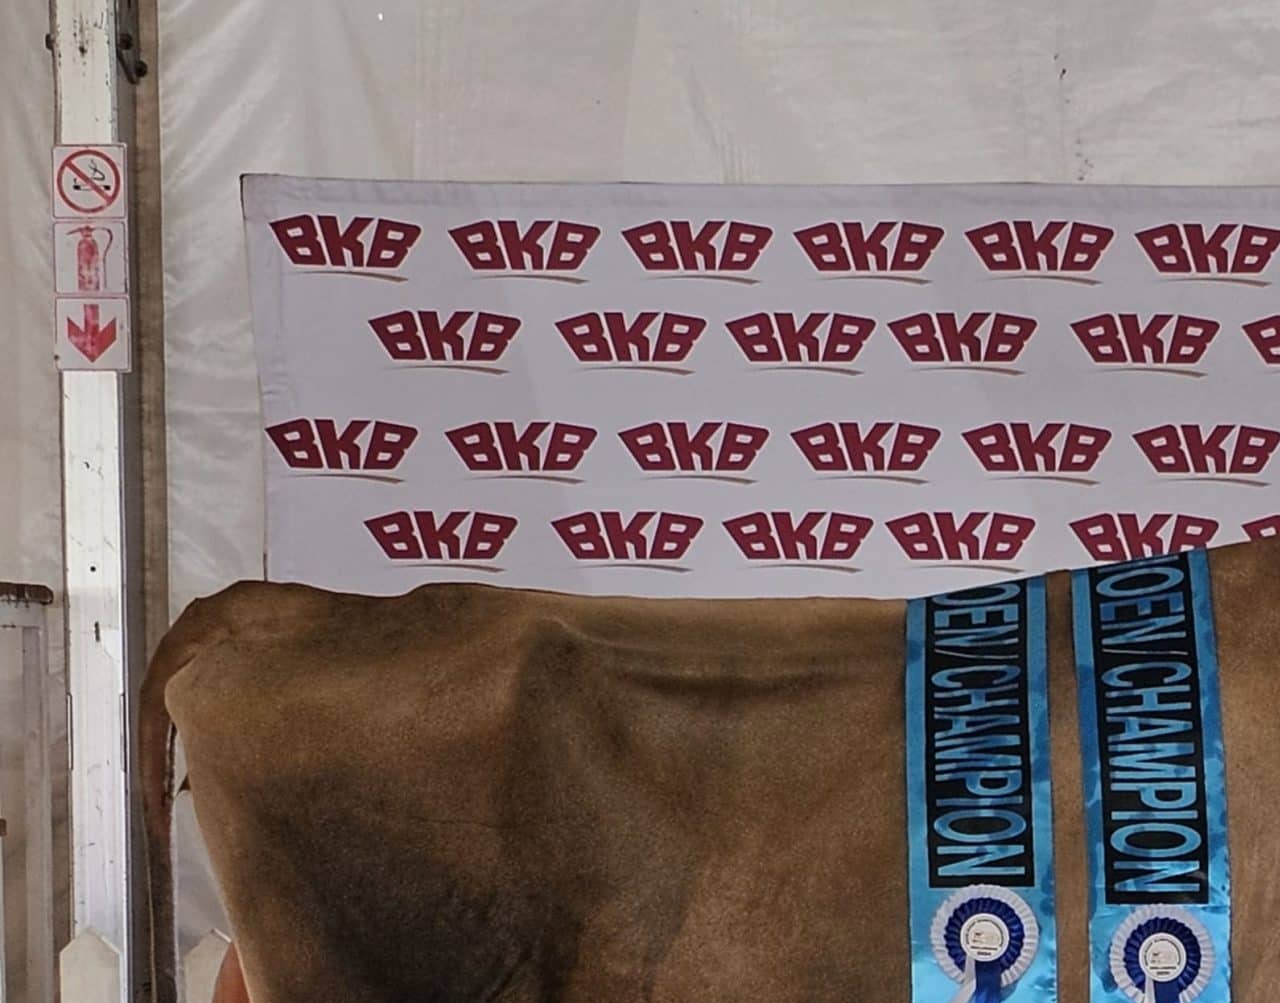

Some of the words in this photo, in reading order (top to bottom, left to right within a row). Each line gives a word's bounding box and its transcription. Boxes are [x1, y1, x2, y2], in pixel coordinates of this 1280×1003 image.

[270, 214, 420, 267] BKB
[448, 220, 599, 269] BKB
[622, 221, 772, 269] BKB
[794, 222, 943, 270] BKB
[965, 221, 1113, 270] BKB
[370, 311, 520, 360] BKB
[556, 312, 705, 361] BKB
[726, 313, 875, 361] BKB
[887, 312, 1036, 361] BKB
[1070, 314, 1219, 363] BKB
[266, 418, 417, 469] BKB
[446, 422, 596, 470] BKB
[618, 422, 768, 470] BKB
[793, 422, 940, 470] BKB
[962, 423, 1110, 471] BKB
[1134, 424, 1280, 472] BKB
[366, 511, 516, 558] BKB
[552, 511, 702, 558] BKB
[724, 512, 872, 559] BKB
[886, 512, 1034, 559] BKB
